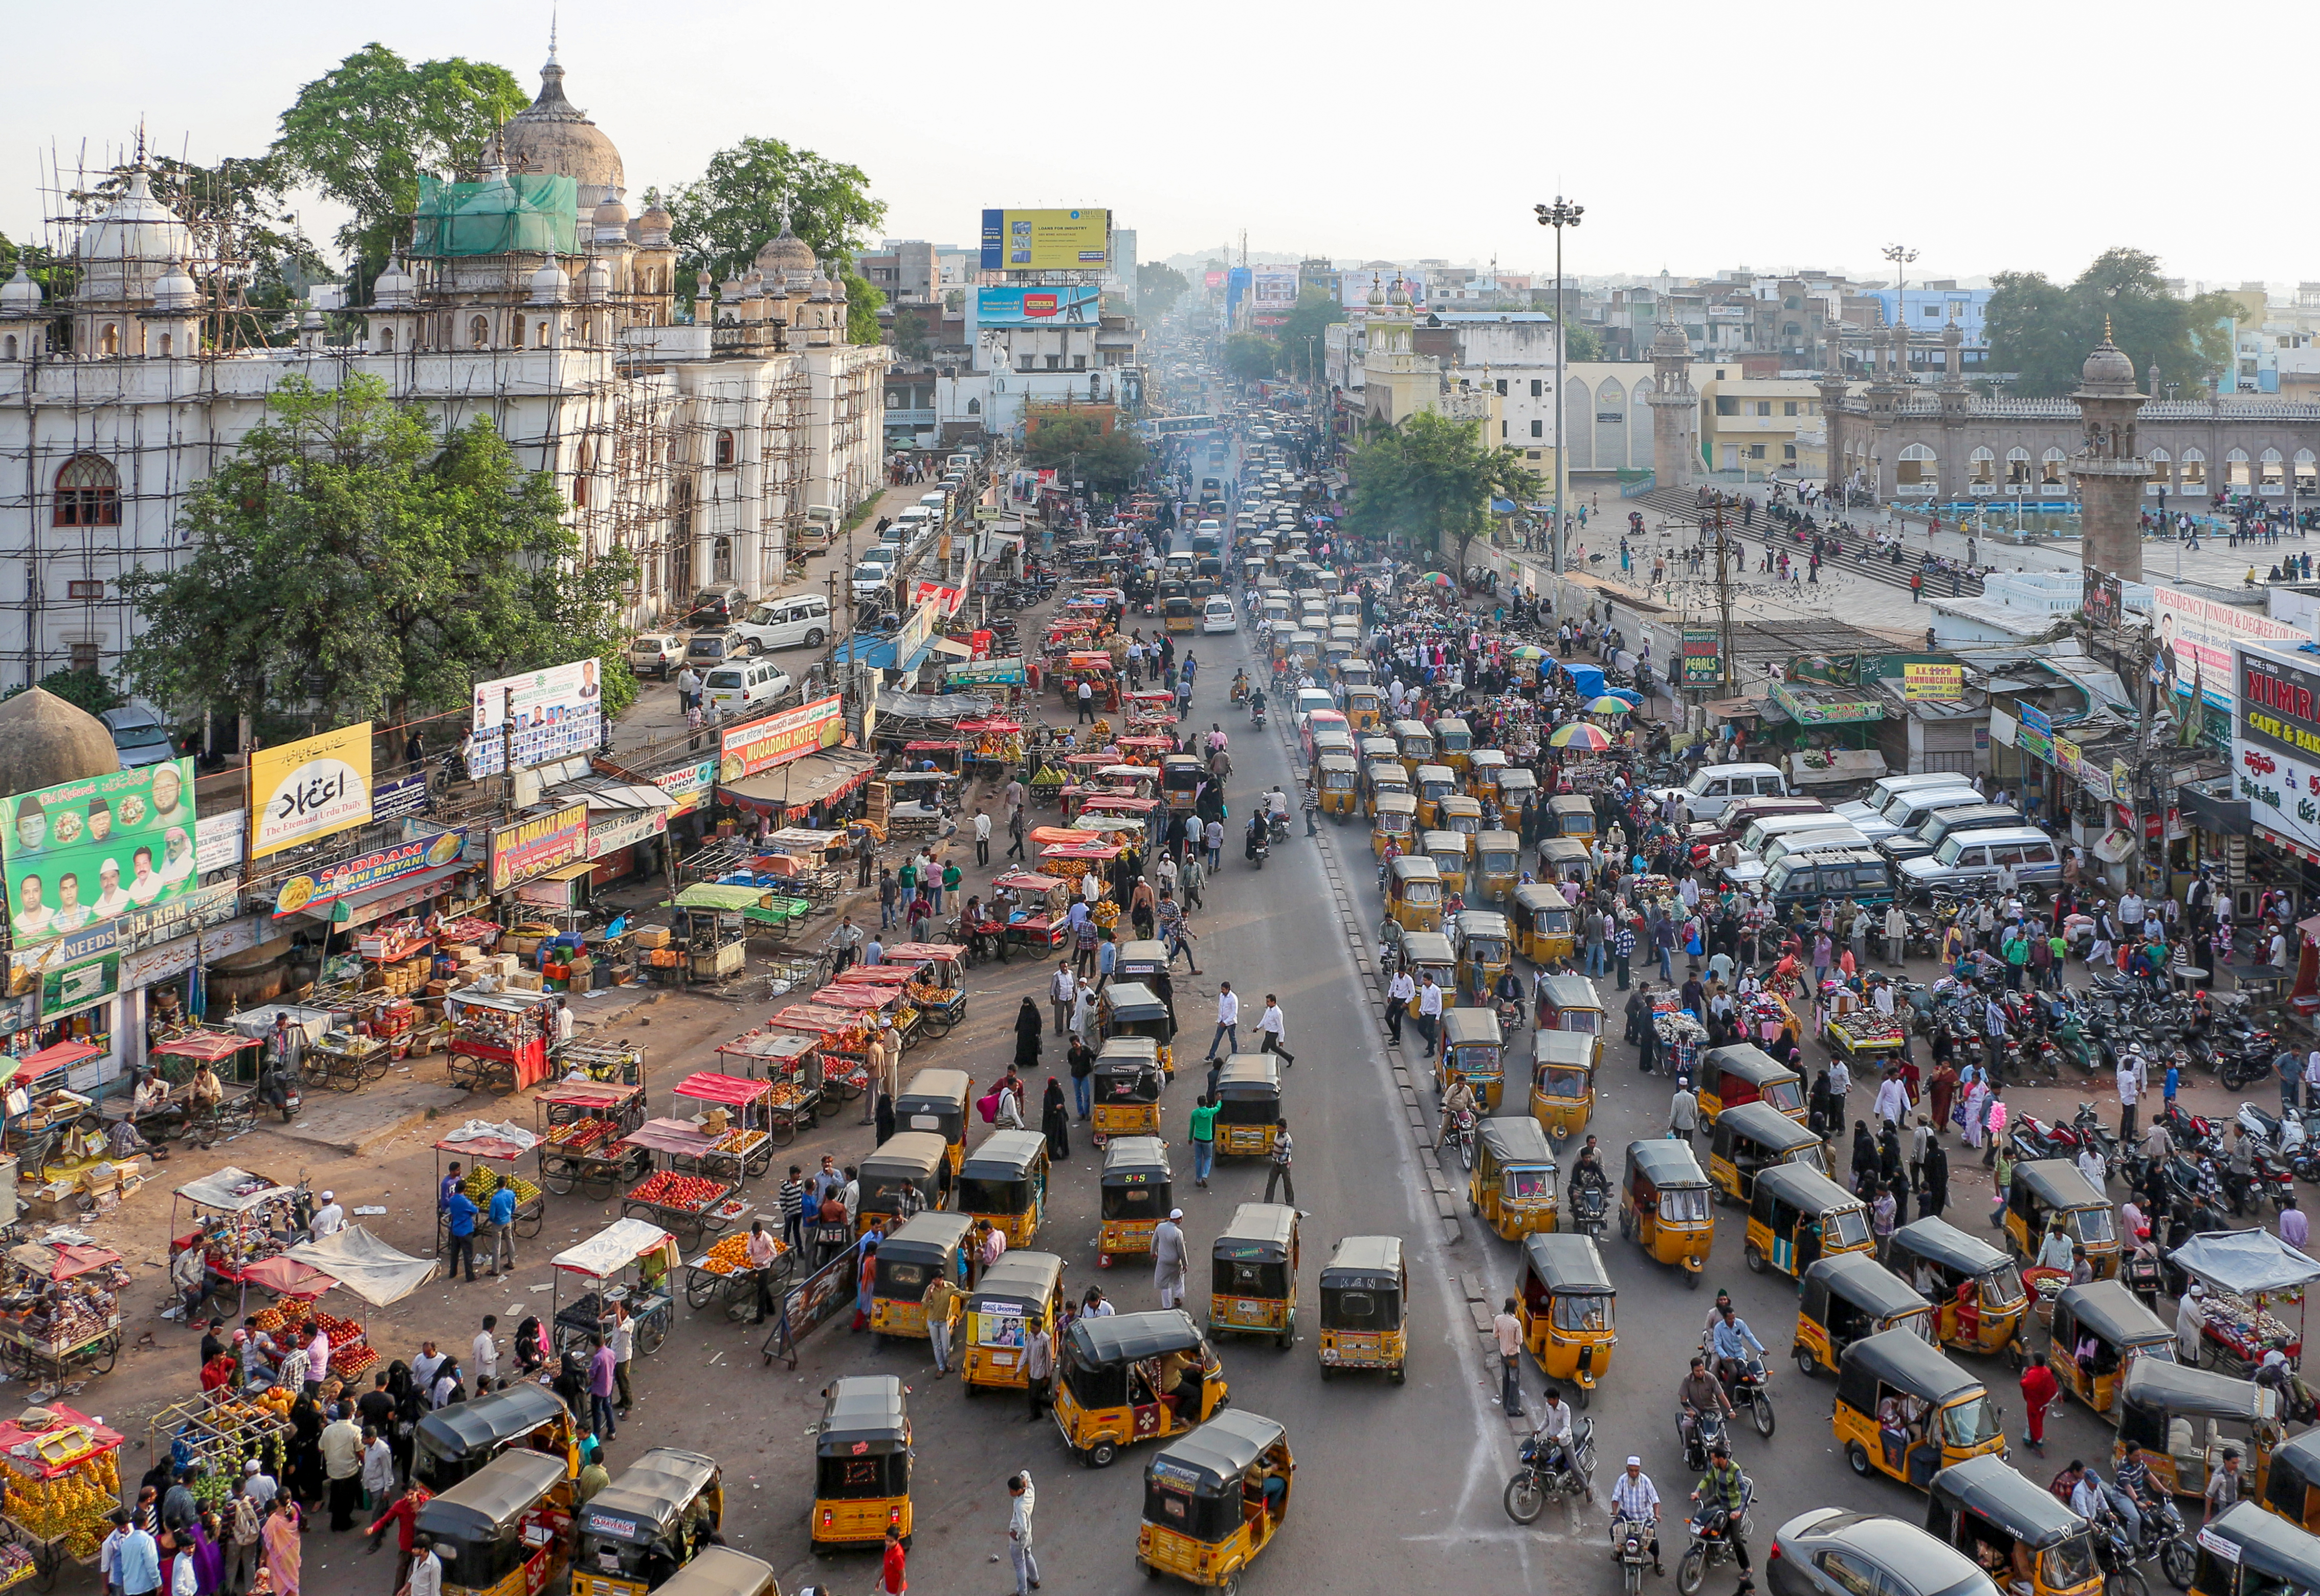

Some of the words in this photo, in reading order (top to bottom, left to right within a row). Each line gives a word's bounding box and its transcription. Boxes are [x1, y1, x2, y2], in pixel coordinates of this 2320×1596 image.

[2154, 587, 2203, 616] PRESIDENCY
[2204, 603, 2234, 626] JUNIOR
[2234, 612, 2242, 628] &
[2242, 615, 2274, 638] DEGREE
[2175, 641, 2192, 656] Groups
[2181, 626, 2210, 644] Separate
[2211, 635, 2230, 651] Block
[1685, 657, 1716, 671] PEARLS
[1929, 666, 1951, 675] STAR
[2266, 662, 2279, 674] 1993
[533, 688, 546, 697] YOUTH
[547, 682, 574, 694] ASSOCIATION
[1906, 676, 1962, 684] COMMUNICATIONS
[746, 728, 762, 740] होटल
[2249, 712, 2281, 738] CAFE
[2283, 724, 2294, 742] &
[746, 733, 791, 763] MUQADDAR
[793, 723, 818, 747] HOTEL
[759, 758, 778, 768] CHICKEN
[653, 768, 696, 786] UNNU
[668, 777, 696, 791] SHOP
[39, 791, 57, 806] Eid
[57, 782, 97, 803] Mubarak
[265, 826, 281, 837] The
[283, 813, 318, 832] Etemaad
[320, 805, 341, 820] Urdu
[341, 800, 362, 813] Daily
[414, 820, 426, 830] ABUL
[496, 829, 517, 854] ABUL
[519, 815, 556, 844] BARKAAT
[557, 803, 587, 830] BAKERY
[590, 819, 619, 838] ROSHAN
[620, 810, 644, 827] SWEET
[320, 842, 424, 883] SADDAM
[520, 857, 533, 866] COOL
[533, 850, 549, 860] DRINKS
[549, 841, 572, 855] AVAILABLE
[373, 853, 426, 879] BIRYANI
[359, 875, 392, 889] MUTTON
[393, 864, 425, 878] BIRYANI
[189, 895, 235, 916] CENTRE
[193, 887, 230, 906] TIFFIN
[136, 901, 187, 934] H.KGN
[65, 930, 115, 960] NEEDS
[1124, 1174, 1132, 1183] S
[1138, 1173, 1145, 1183] S
[601, 1520, 634, 1532] MAVERICK
[2005, 1524, 2024, 1539] 2013
